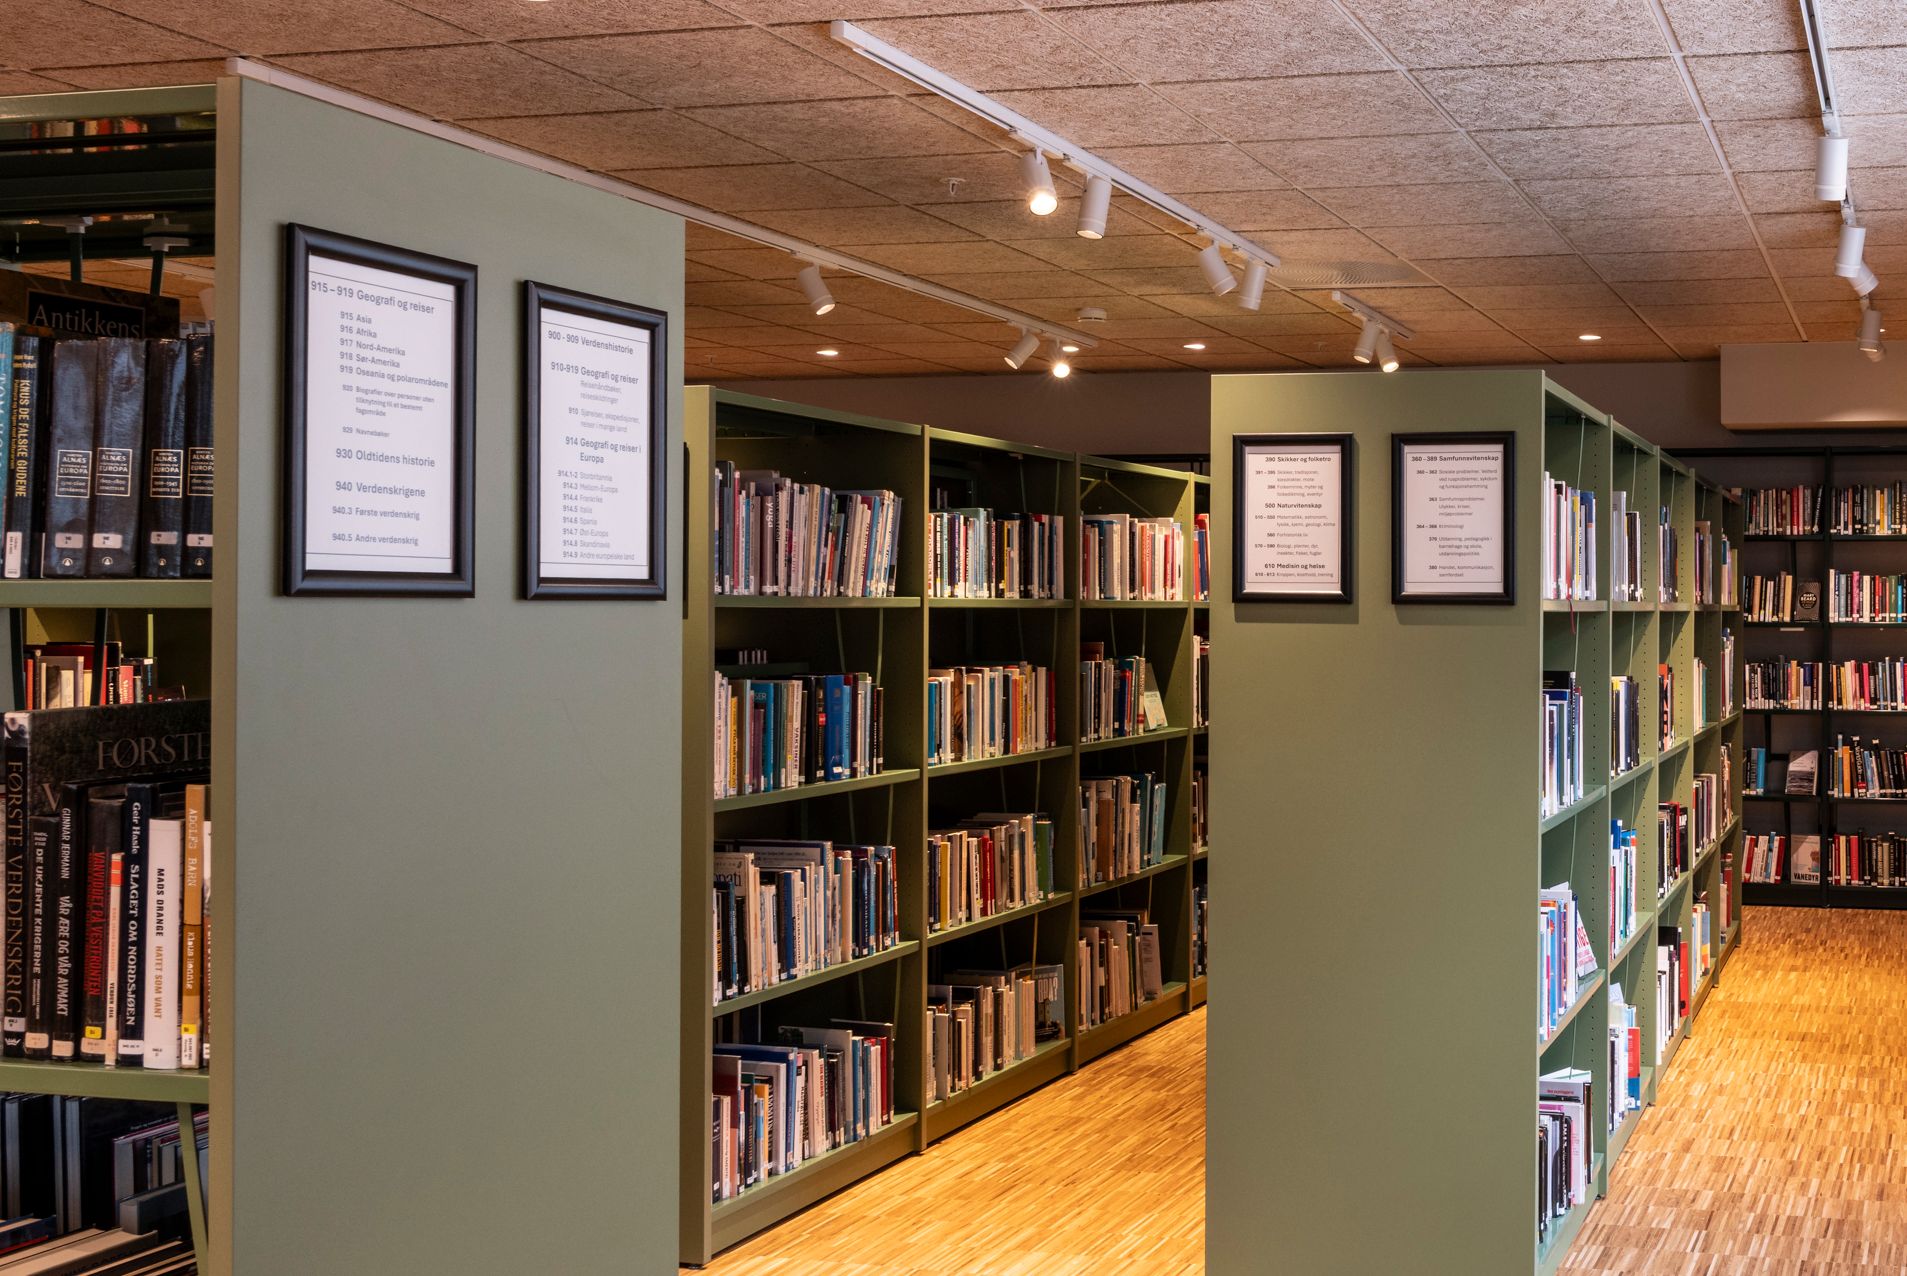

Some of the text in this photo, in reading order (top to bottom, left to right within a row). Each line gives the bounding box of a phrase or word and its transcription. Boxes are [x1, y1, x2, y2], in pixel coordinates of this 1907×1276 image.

[311, 281, 328, 293] 915
[337, 286, 353, 298] 919
[357, 290, 395, 306] Geografi
[398, 300, 407, 311] og
[410, 302, 434, 314] reiser
[32, 303, 140, 338] Antikkens
[340, 311, 371, 324] 915 Asia
[340, 325, 377, 338] 916 Afrika
[548, 330, 561, 340] 900
[567, 334, 579, 343] 909
[581, 336, 633, 355] Verdenshistorie
[340, 338, 405, 356] 917 Nord-Amerika
[356, 354, 400, 368] Sør-Amerika
[340, 365, 448, 388] 919 Oseania og polarområdene
[581, 367, 609, 380] Geografi
[611, 373, 618, 382] og
[620, 374, 638, 384] reiser
[18, 379, 31, 405] KNUS
[18, 408, 30, 420] DE
[17, 422, 30, 456] FALSKE
[566, 436, 578, 445] 914
[580, 438, 608, 450] Geografi
[610, 443, 618, 452] og
[620, 443, 638, 452] reiser
[336, 448, 435, 467] 930 Oldtidens historie
[580, 453, 604, 464] Europa
[15, 460, 28, 497] GUDENE
[336, 481, 425, 498] 940 Verdenskrigene
[332, 506, 419, 521] 940.3 Første verdenskrig
[765, 502, 773, 528] yoga
[332, 533, 418, 546] 940.5 Andre verdenskrig
[8, 761, 23, 846] FØRSTE
[36, 848, 44, 863] DE
[34, 866, 43, 915] UKJENTE
[92, 851, 106, 907] VANVIDDET
[56, 808, 72, 1016] GUNNAR JERMANN VÅR ÆRE OG VÅR AVMAKT
[126, 802, 141, 1026] Geir Hasle SLAGET OM NORDSJØEN
[7, 855, 23, 1013] VERDENSKRIG
[33, 918, 42, 974] KRIGERNE
[154, 868, 165, 1019] MADS DRANGE HATET SOM VANT
[89, 926, 104, 996] VESTFRONTEN
